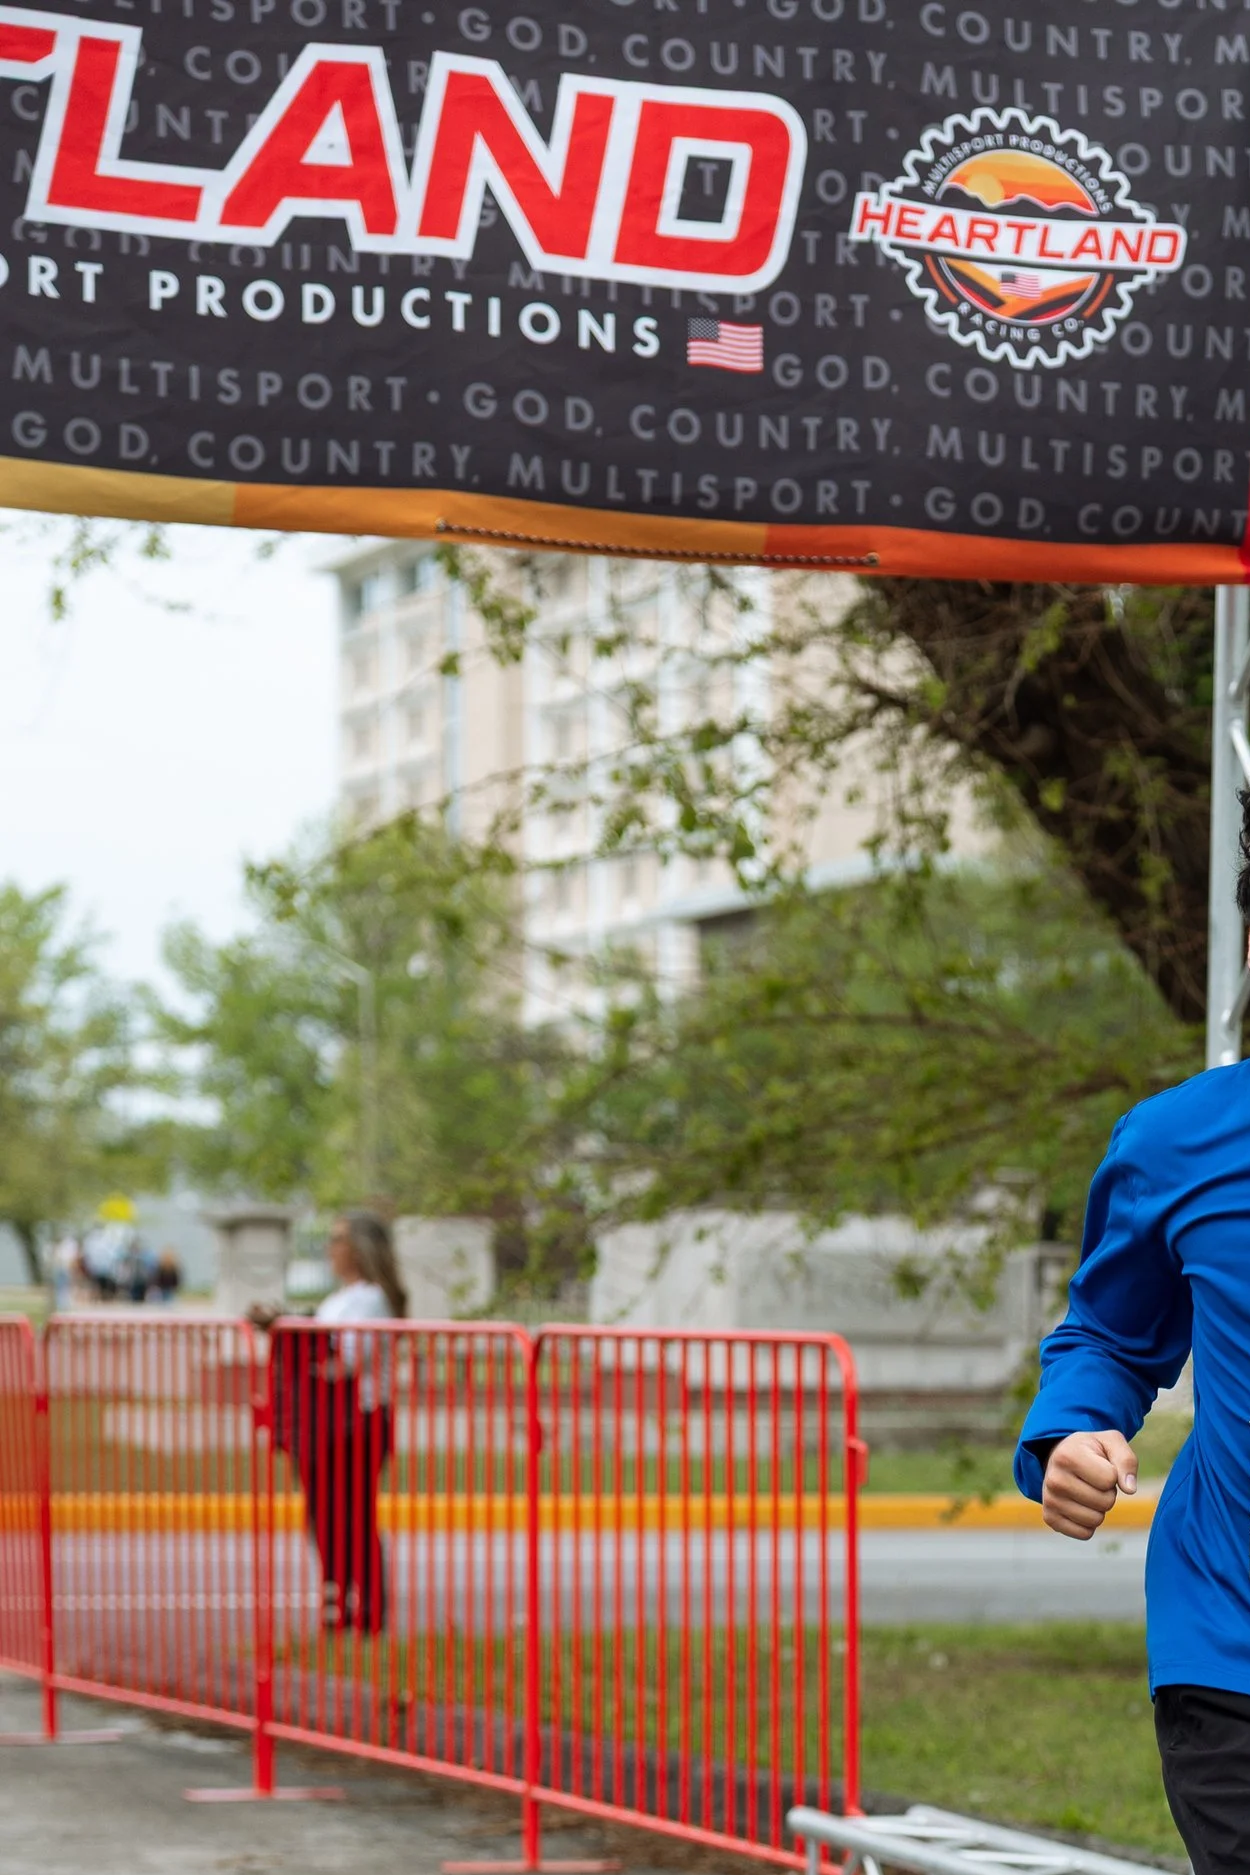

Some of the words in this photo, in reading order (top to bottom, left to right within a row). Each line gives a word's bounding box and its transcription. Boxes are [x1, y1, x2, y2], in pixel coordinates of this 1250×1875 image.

[0, 5, 807, 295] LAND
[923, 133, 1004, 197] MULTISPORT
[1009, 133, 1114, 214] PRODUCTIONS
[855, 198, 1181, 265] HEARTLAND
[0, 253, 104, 303] RT
[149, 269, 661, 358] PRODUCTIONS
[957, 301, 1041, 341] RACING
[12, 345, 408, 411] MULTISPORT
[507, 452, 872, 514] MULTISPORT
